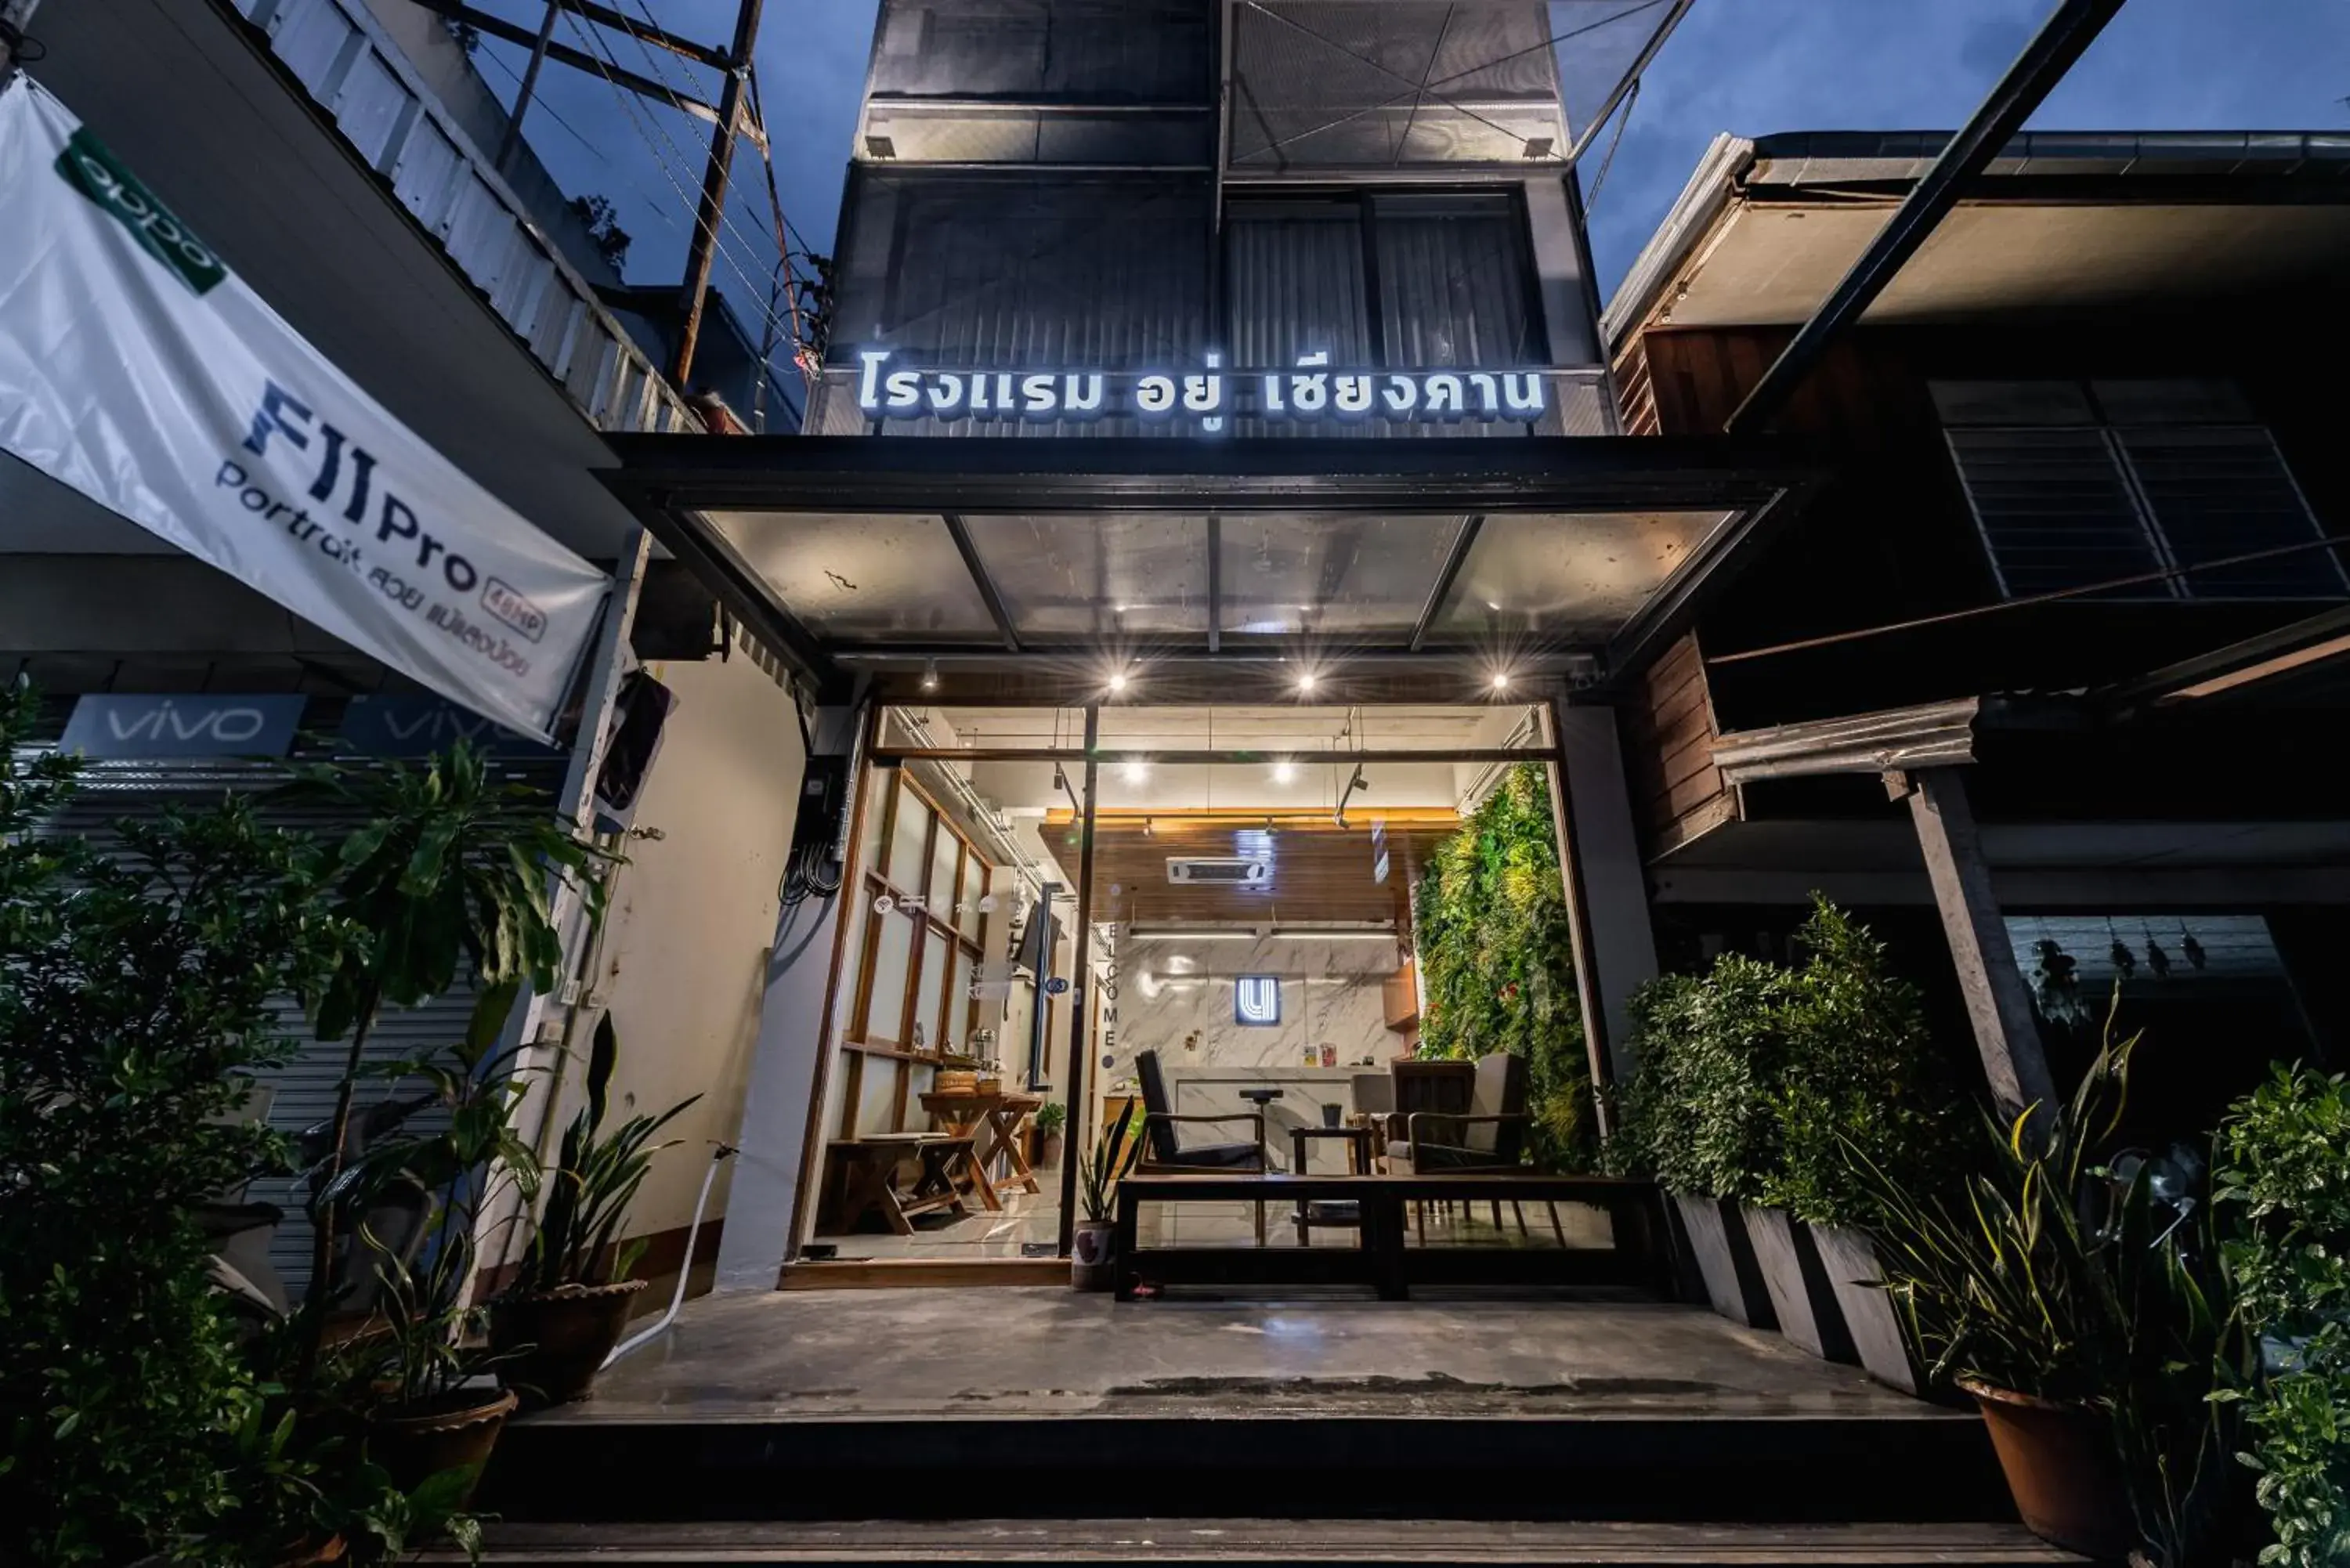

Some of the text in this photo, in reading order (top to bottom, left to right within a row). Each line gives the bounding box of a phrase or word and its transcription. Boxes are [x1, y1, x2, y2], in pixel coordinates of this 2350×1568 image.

[859, 350, 1546, 432] โรงแรม อยู่ เชียงคาน
[215, 460, 361, 573] Portrait
[376, 490, 478, 593] Pro
[107, 699, 264, 741] vivo
